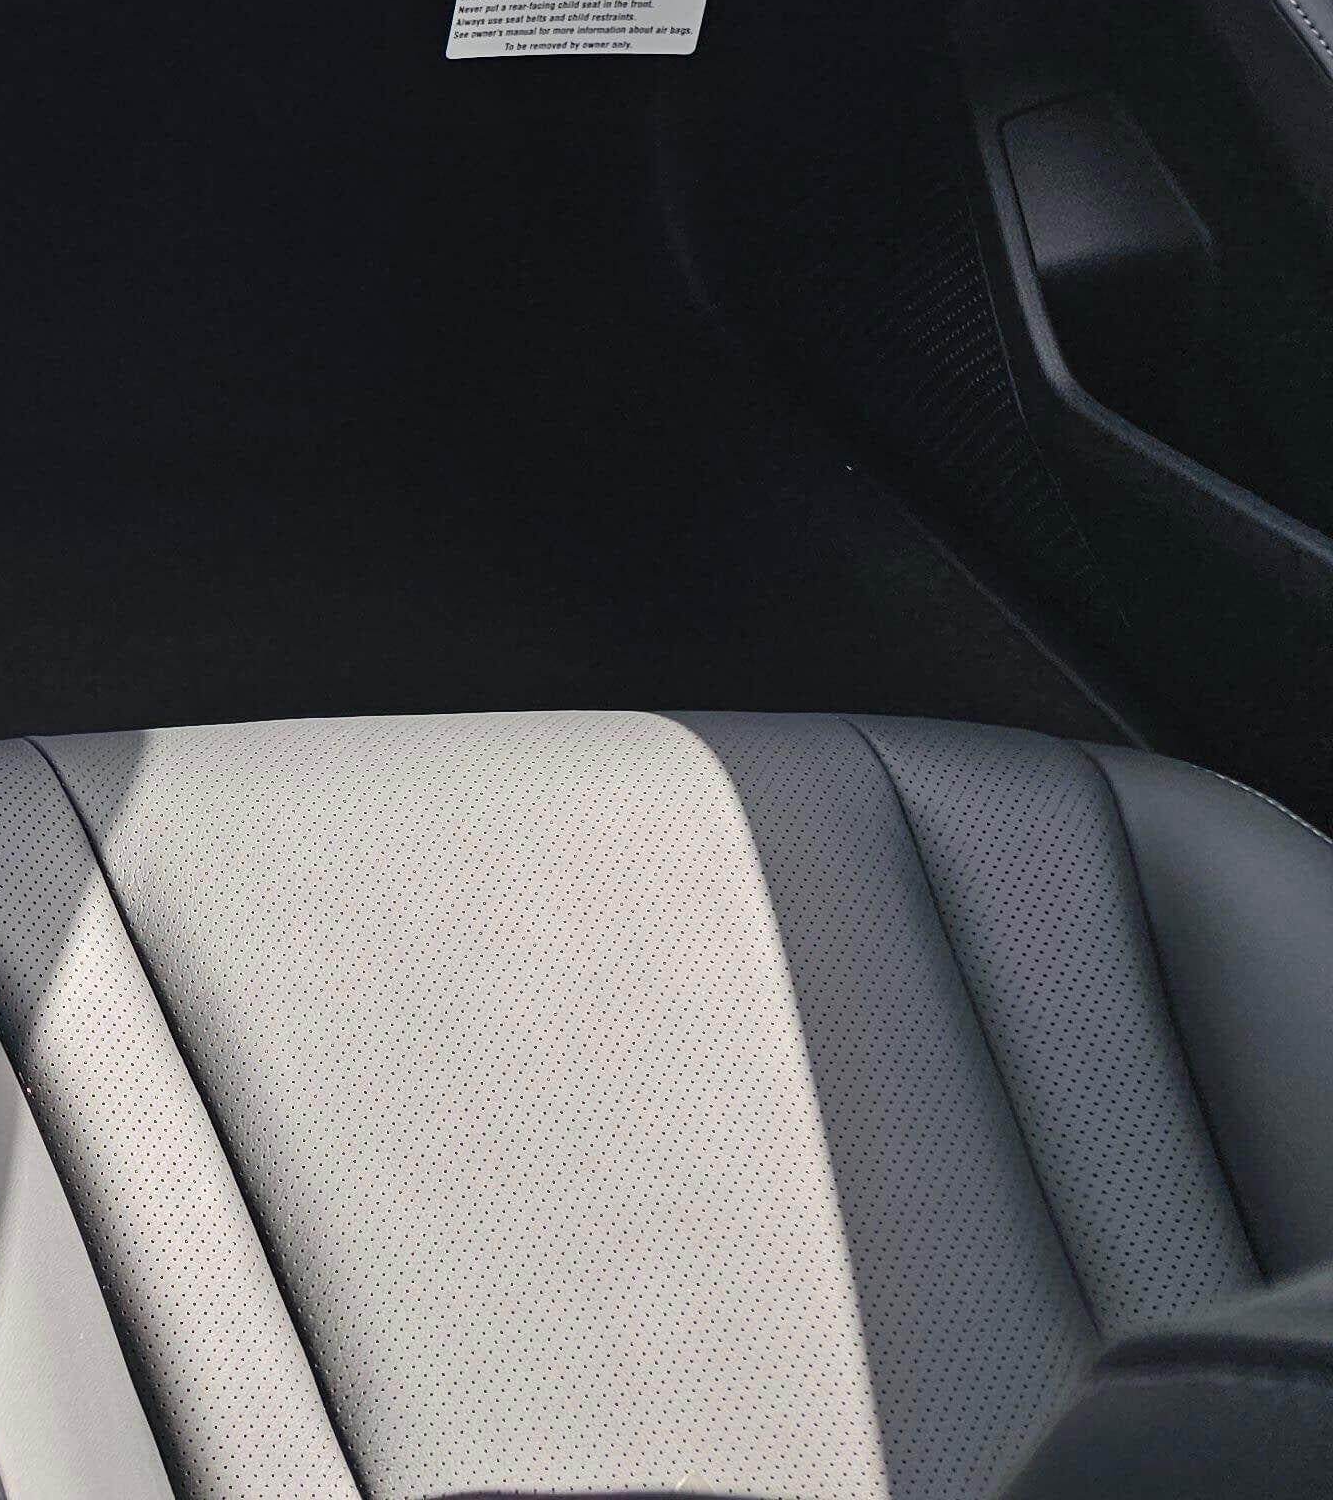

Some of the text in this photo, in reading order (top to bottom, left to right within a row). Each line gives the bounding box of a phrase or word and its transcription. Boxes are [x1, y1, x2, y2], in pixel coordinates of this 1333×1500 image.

[459, 6, 483, 14] Never
[485, 4, 499, 13] put
[509, 2, 555, 10] rear-facing
[558, 1, 579, 9] child
[614, 0, 628, 8] the
[456, 19, 485, 27] Always
[526, 15, 546, 23] belts
[549, 14, 565, 22] and
[568, 13, 589, 21] child
[453, 31, 469, 39] See
[471, 30, 503, 38] owner's
[505, 28, 537, 36] manual
[577, 26, 626, 34] information
[629, 26, 653, 34] about
[505, 43, 514, 51] To
[517, 42, 527, 50] be
[530, 42, 567, 50] removed
[570, 42, 580, 50] by
